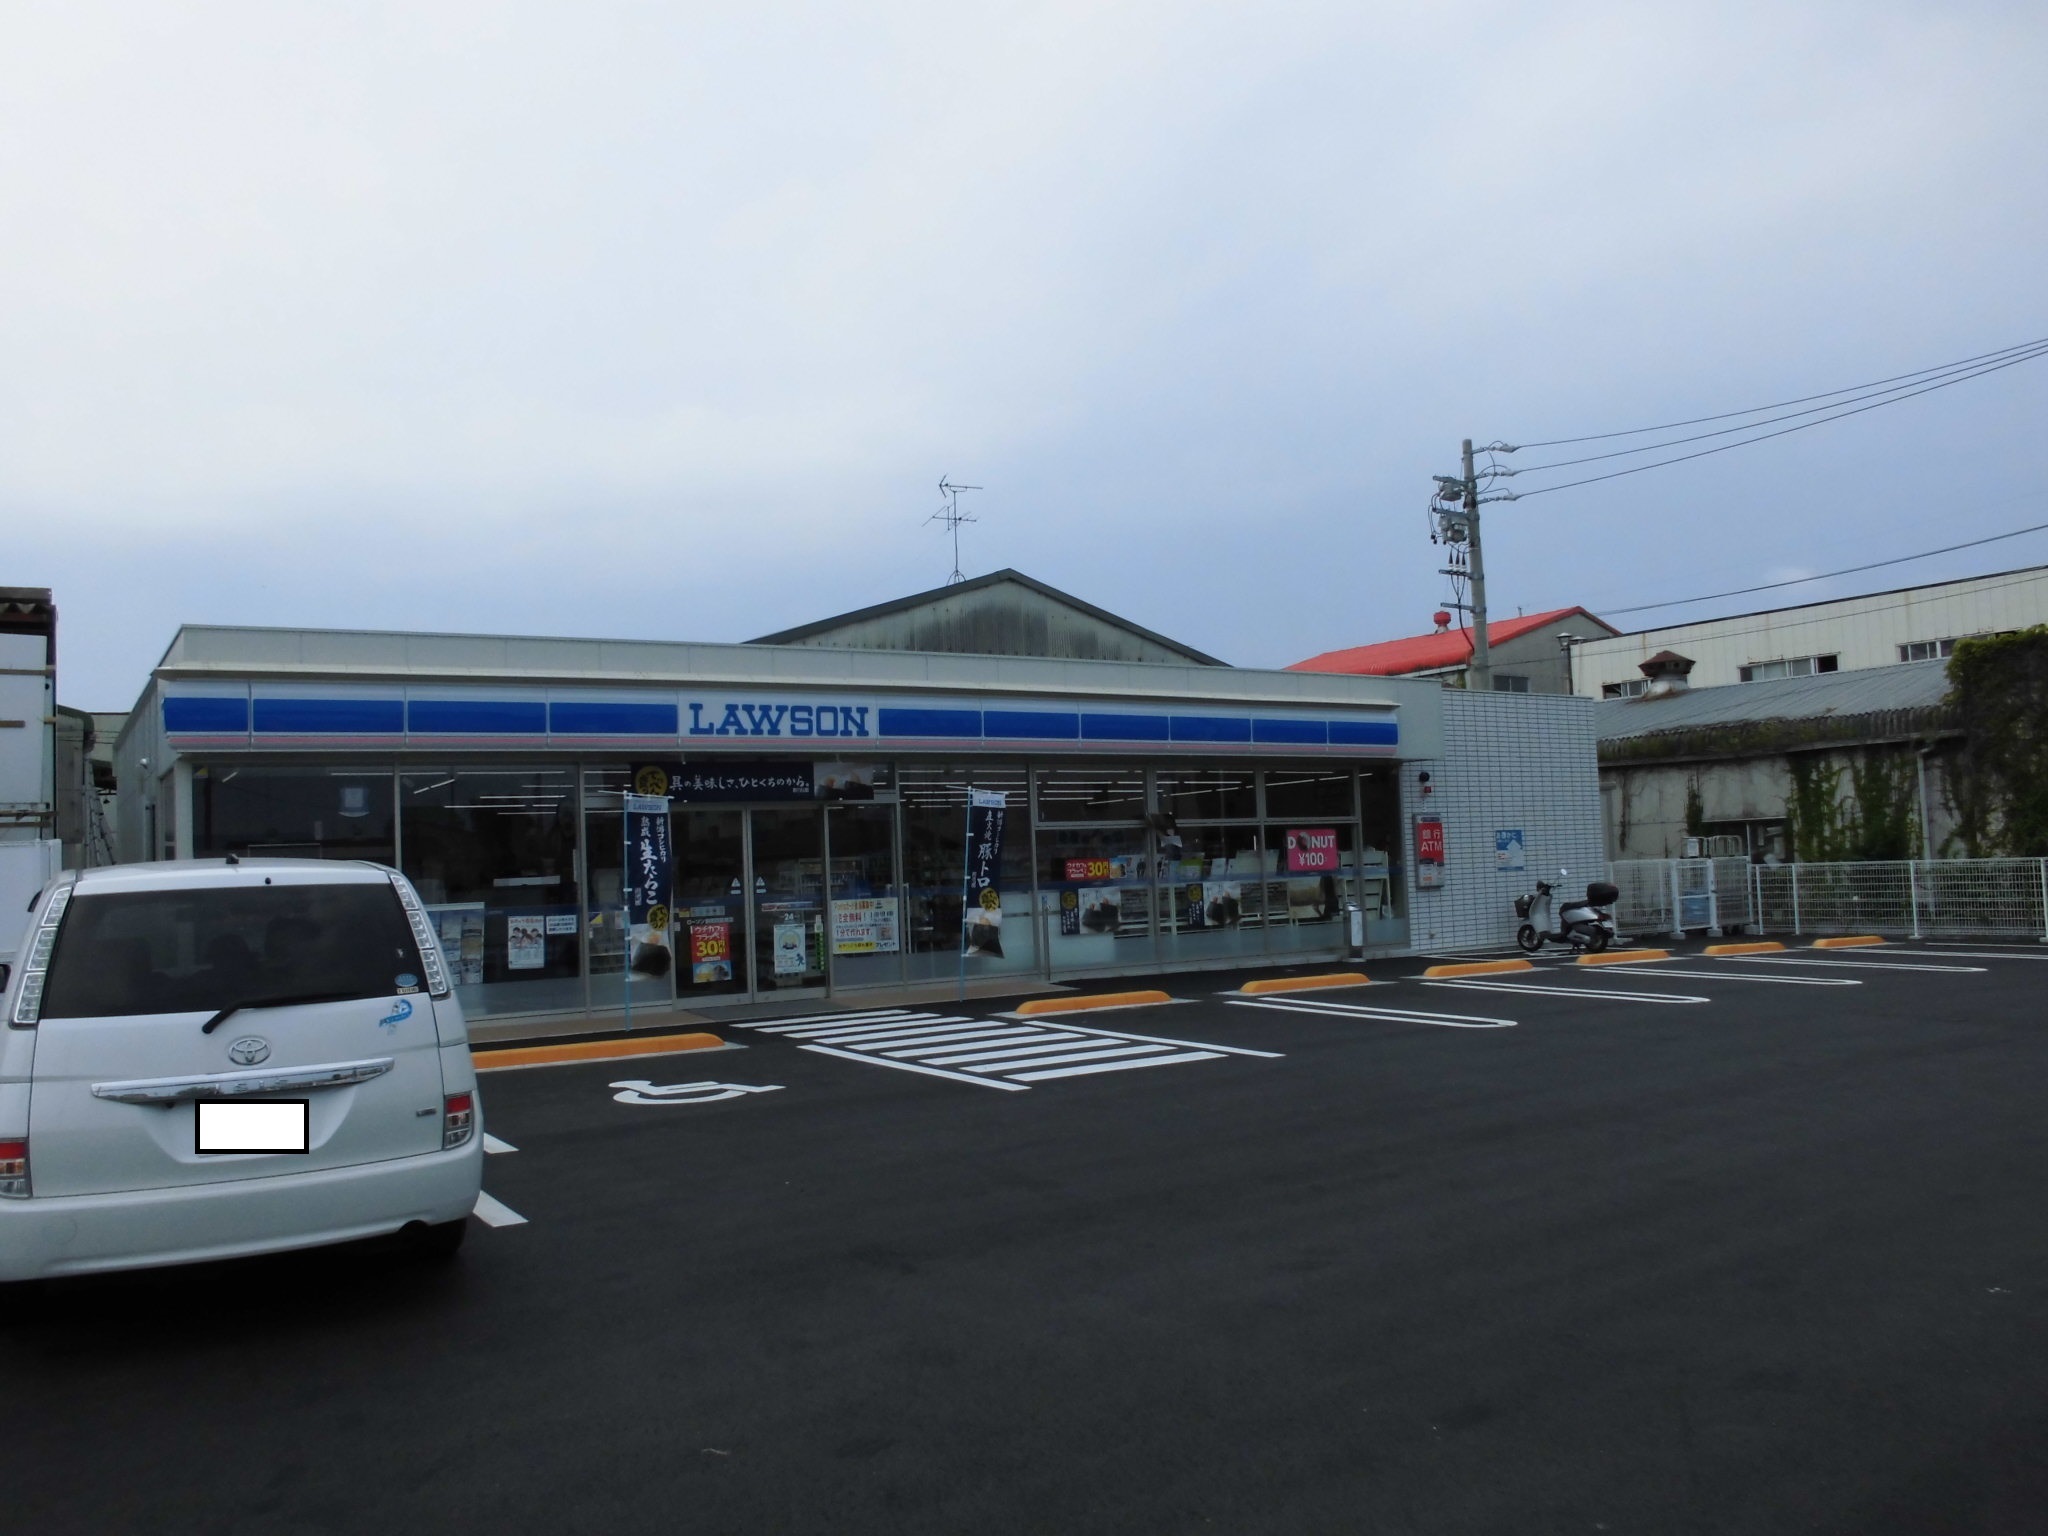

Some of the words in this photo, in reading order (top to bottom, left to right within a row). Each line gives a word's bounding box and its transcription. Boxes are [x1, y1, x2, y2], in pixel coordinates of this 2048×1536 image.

[689, 703, 868, 736] LAWSON
[1420, 841, 1443, 852] ATM
[1299, 852, 1324, 867] ¥100
